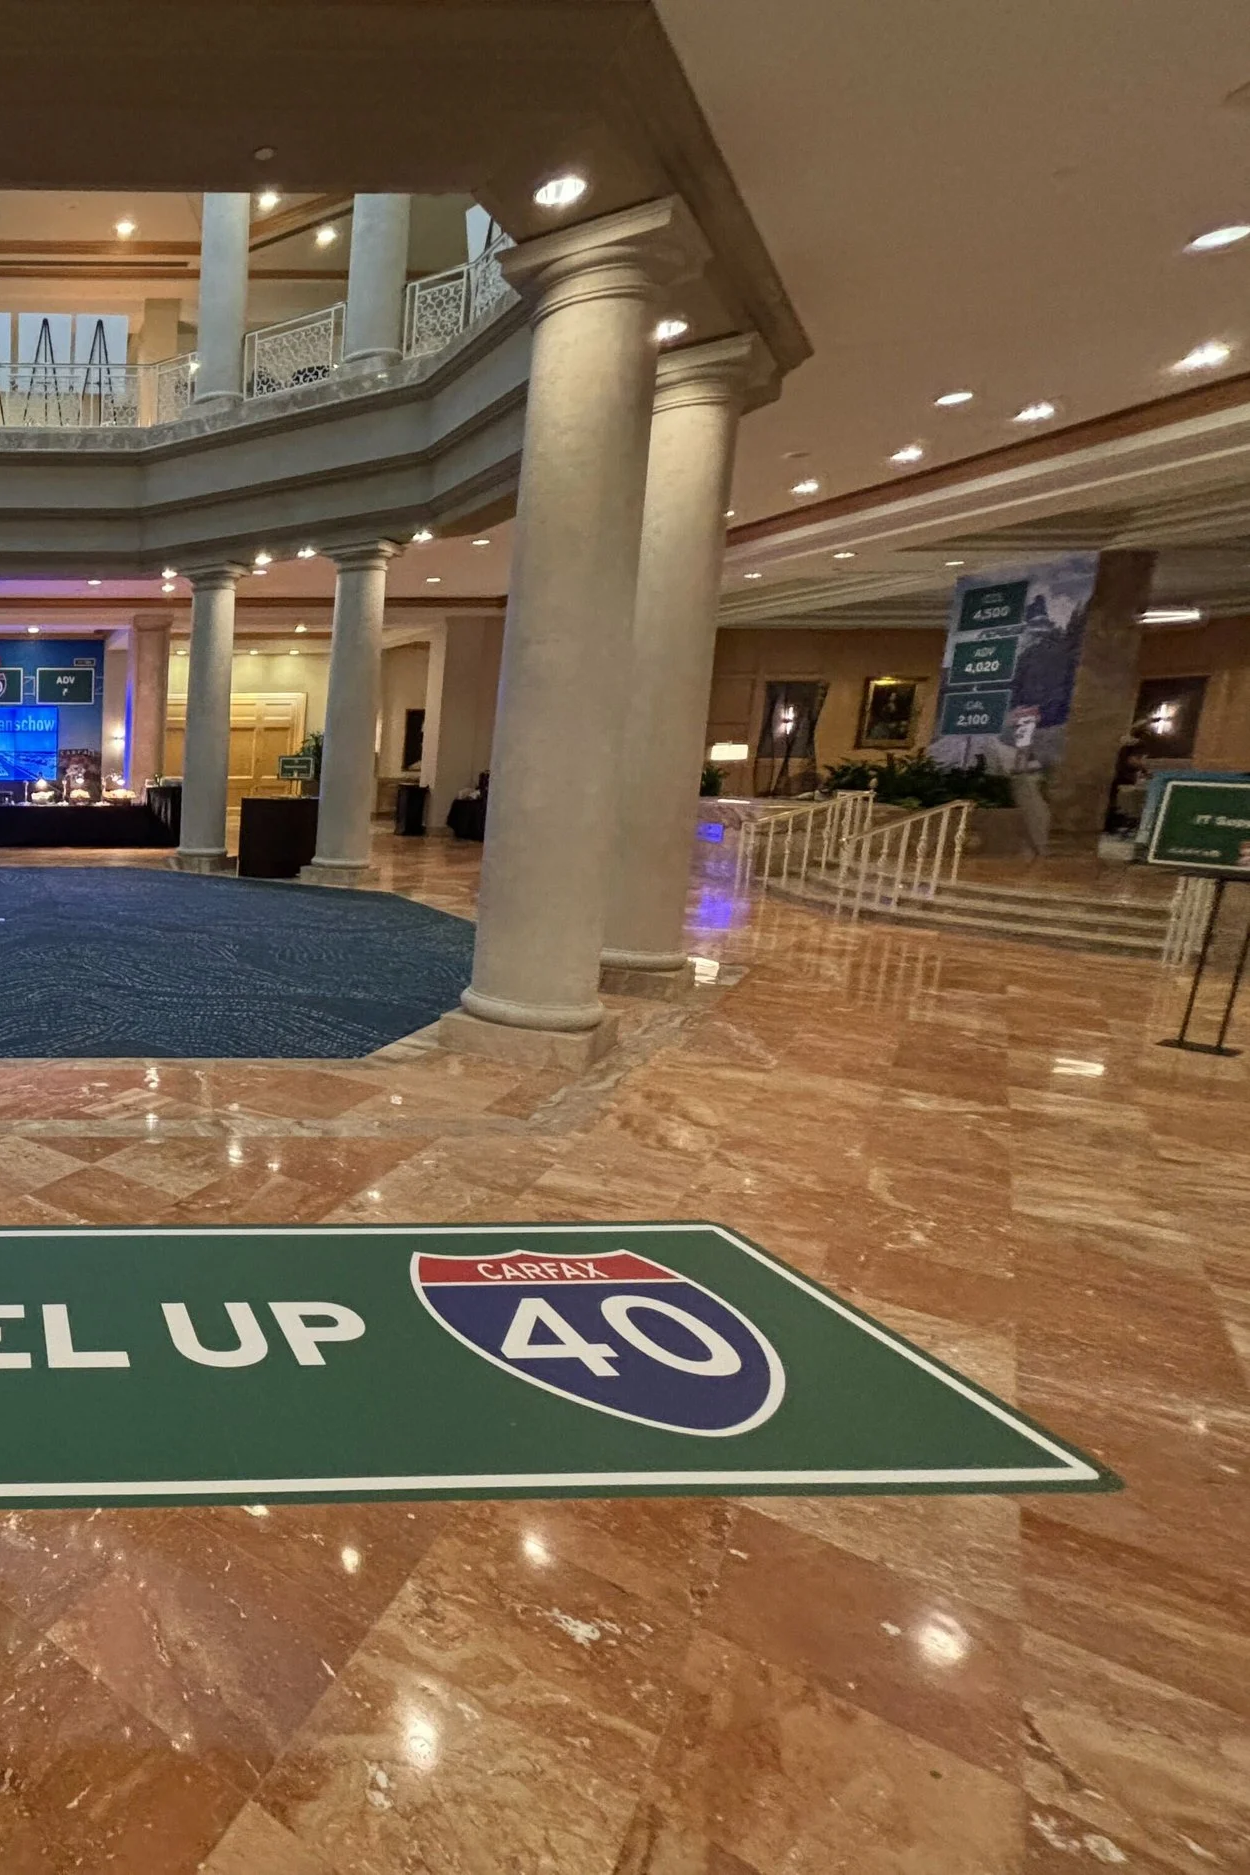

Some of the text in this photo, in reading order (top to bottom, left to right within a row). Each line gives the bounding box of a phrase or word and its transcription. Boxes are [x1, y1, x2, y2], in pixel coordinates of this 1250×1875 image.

[964, 660, 1000, 673] 4,020
[56, 676, 76, 684] ADV
[956, 713, 990, 727] 2,100
[477, 1262, 609, 1280] CARFAX
[161, 1302, 366, 1367] UP
[501, 1295, 742, 1376] 40
